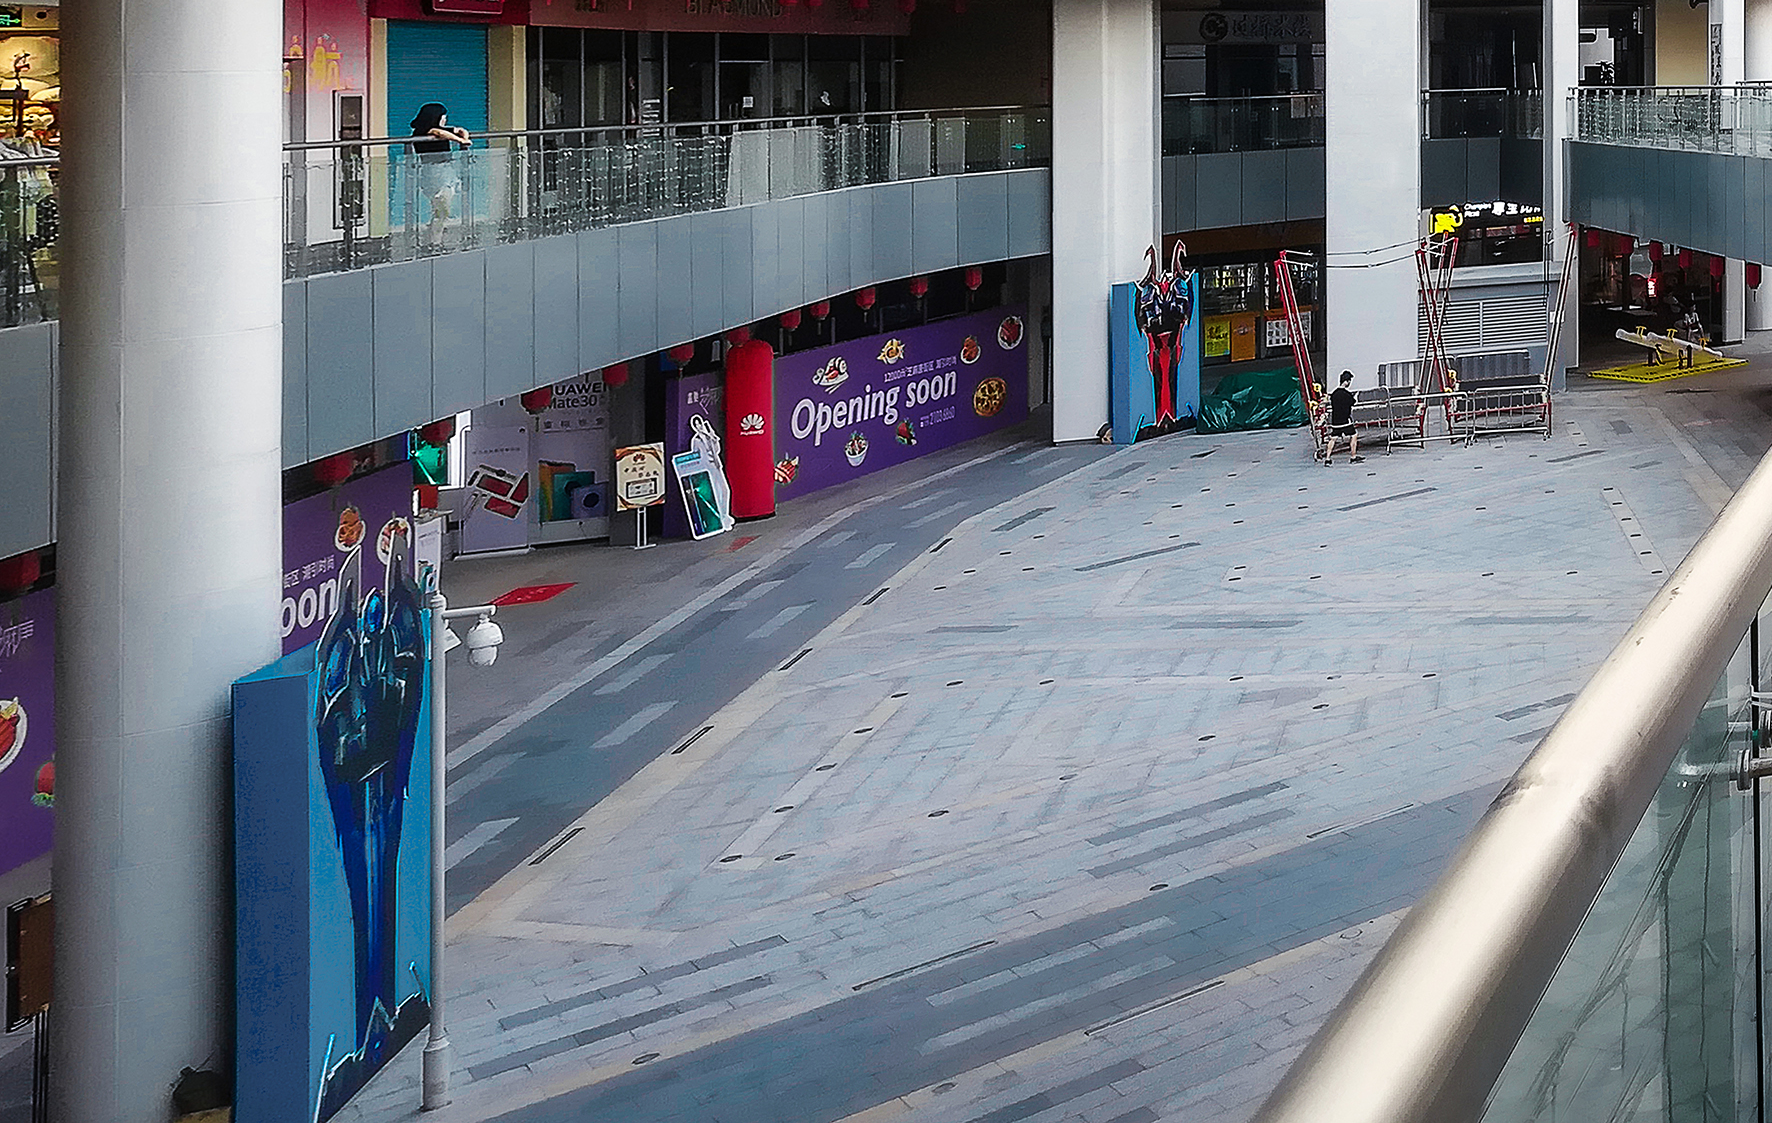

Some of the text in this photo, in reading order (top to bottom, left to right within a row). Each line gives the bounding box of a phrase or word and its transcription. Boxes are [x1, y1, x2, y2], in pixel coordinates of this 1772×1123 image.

[554, 382, 607, 396] UAWEI
[791, 383, 901, 446] Opening
[905, 370, 958, 408] soon
[281, 577, 337, 639] oon
